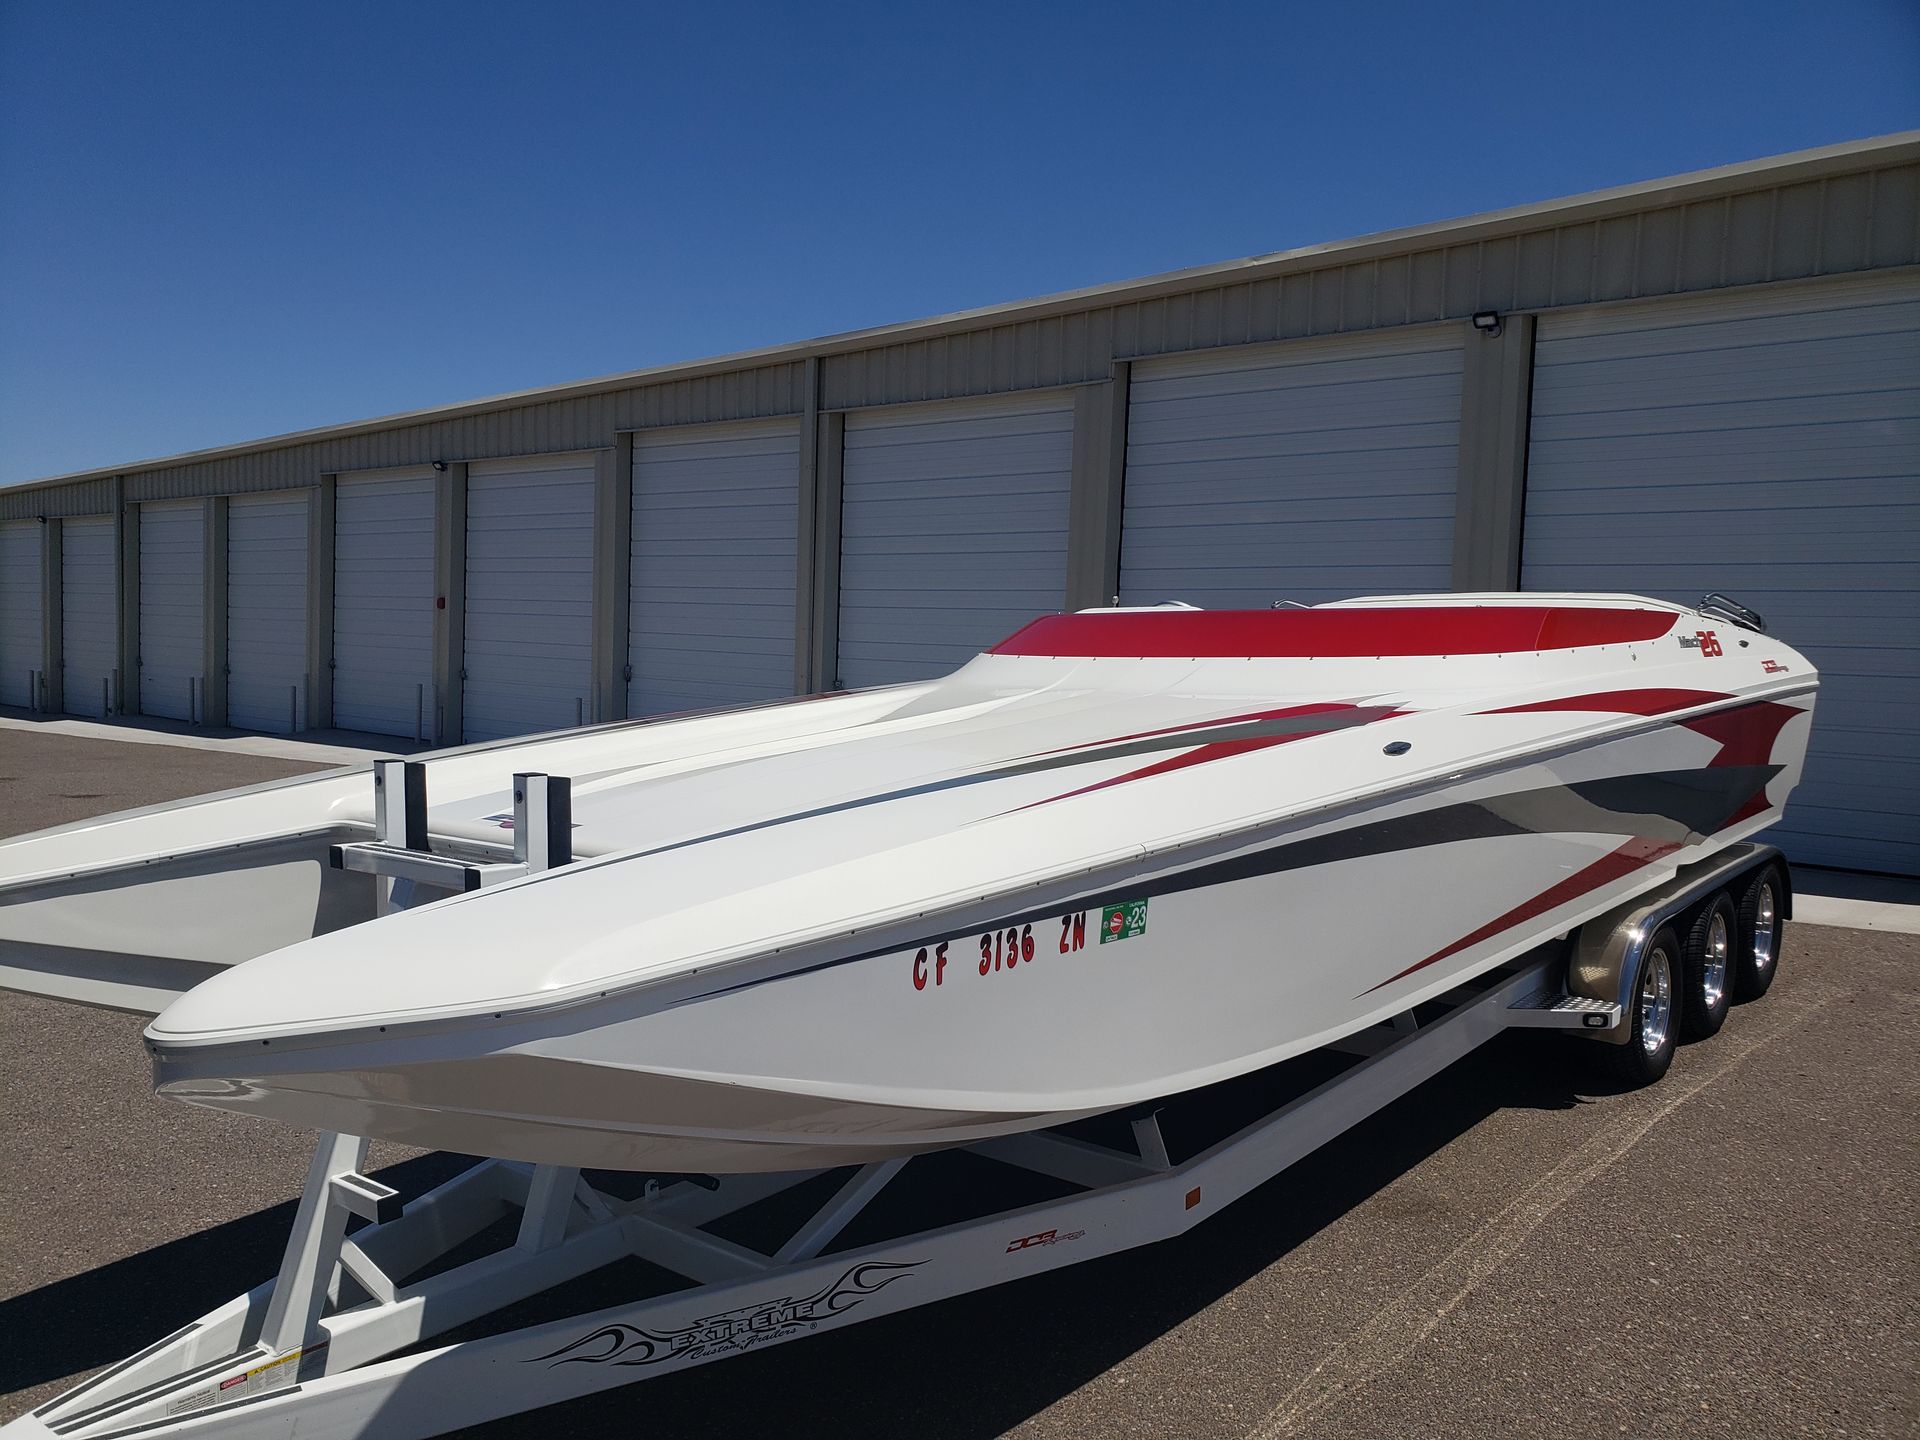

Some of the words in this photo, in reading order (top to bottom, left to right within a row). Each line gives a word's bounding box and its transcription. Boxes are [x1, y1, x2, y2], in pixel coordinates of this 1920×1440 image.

[1696, 631, 1723, 657] 26
[1131, 906, 1147, 928] 23
[912, 941, 949, 991] CF
[979, 923, 1035, 976] 3136
[1060, 911, 1087, 954] ZN
[671, 1303, 815, 1351] EXTREME
[690, 1342, 741, 1360] Custom
[742, 1327, 797, 1350] Trailers
[223, 1376, 245, 1388] DANGER
